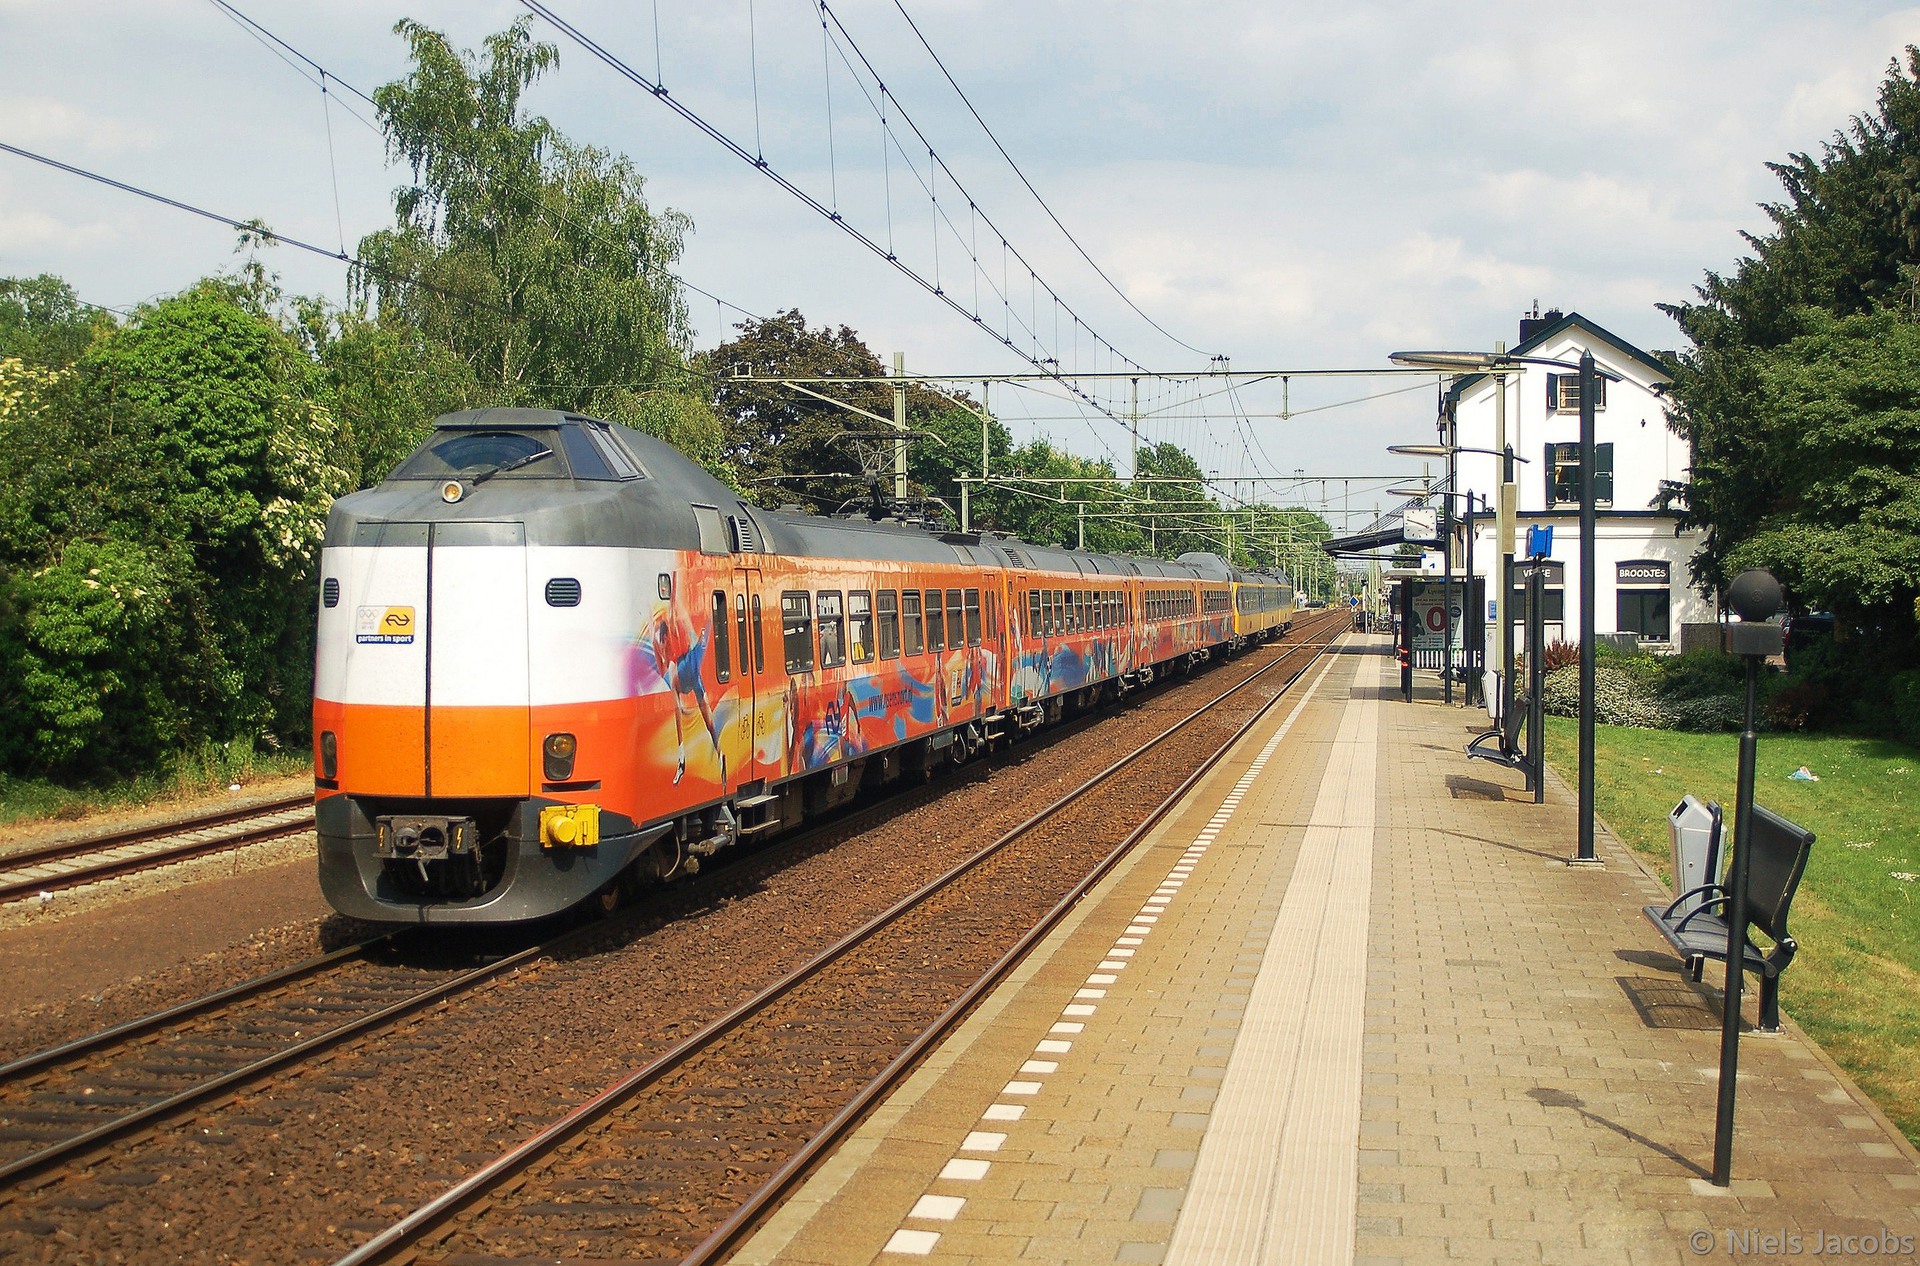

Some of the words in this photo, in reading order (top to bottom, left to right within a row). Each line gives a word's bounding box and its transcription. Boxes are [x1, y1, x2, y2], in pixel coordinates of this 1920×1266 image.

[1619, 569, 1666, 578] BROODJES
[358, 635, 383, 643] partners
[393, 635, 411, 643] sport
